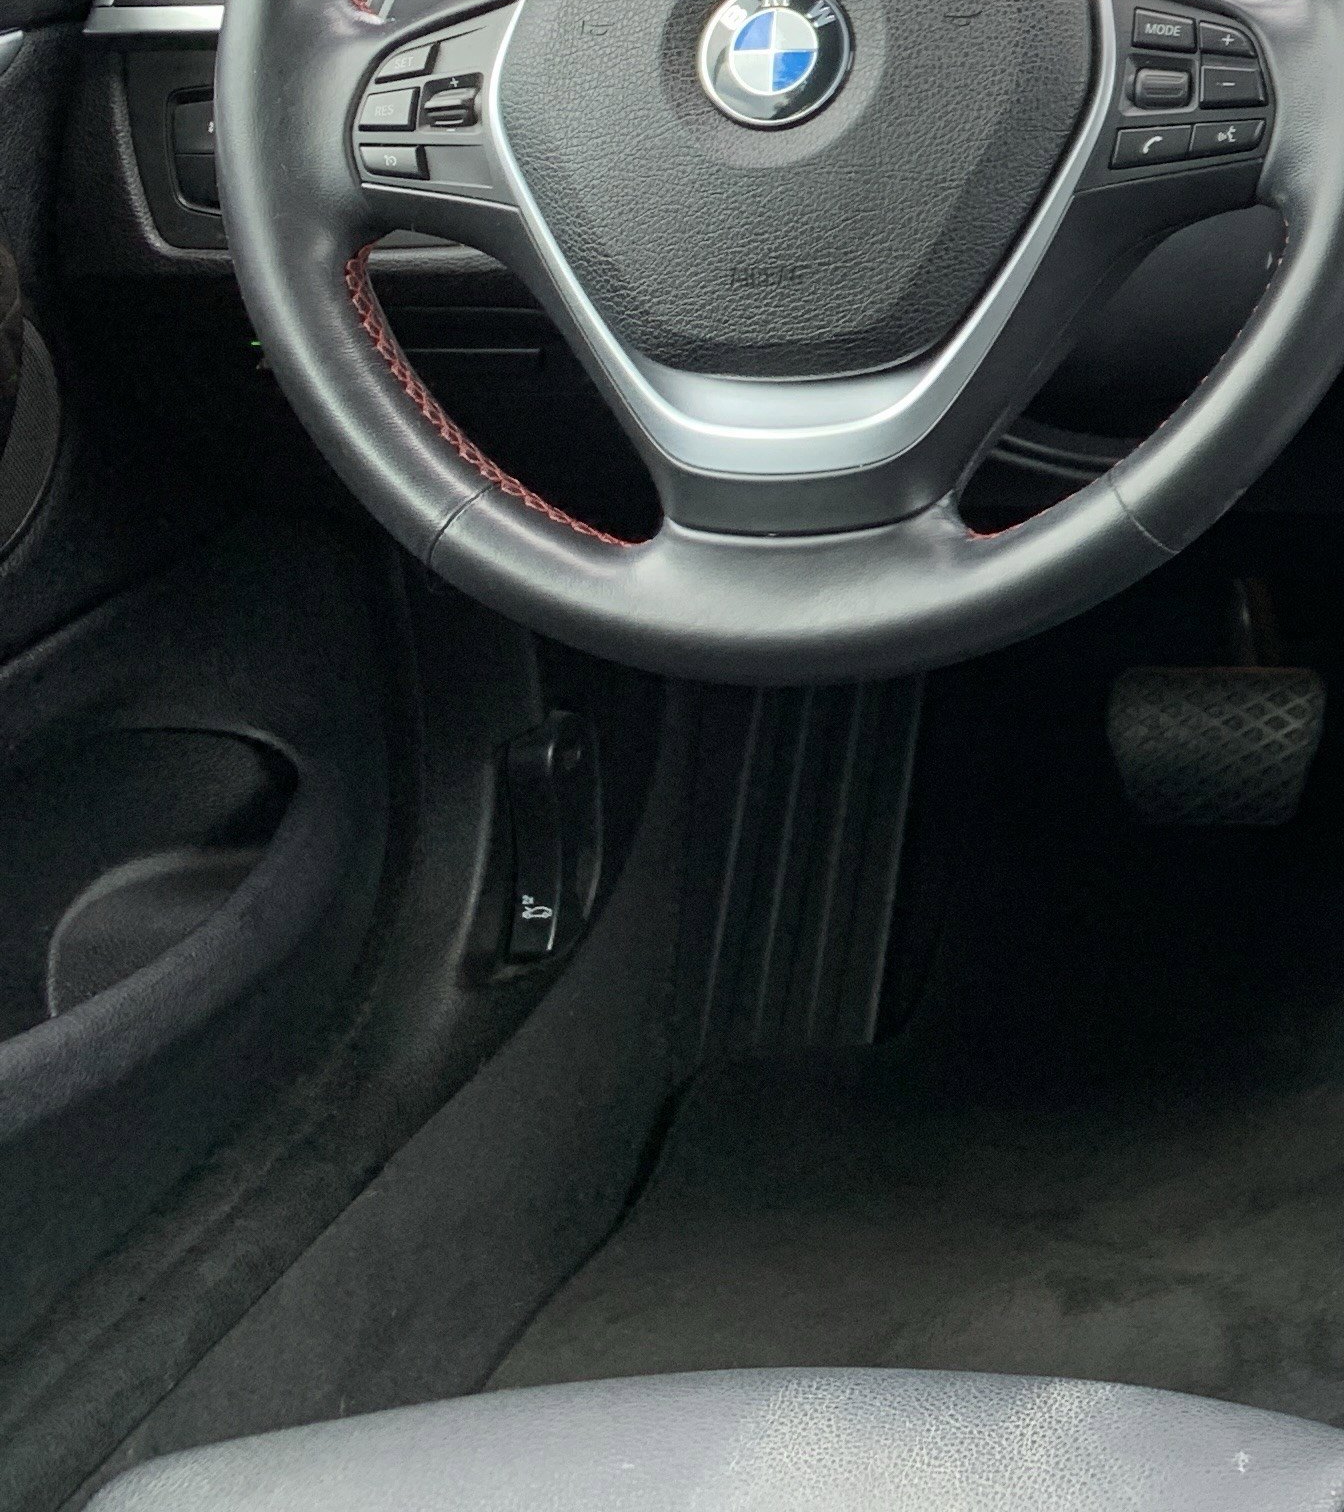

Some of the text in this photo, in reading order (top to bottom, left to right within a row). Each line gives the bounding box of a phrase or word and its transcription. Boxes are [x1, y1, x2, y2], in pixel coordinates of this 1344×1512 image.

[1145, 23, 1182, 37] MODE
[394, 57, 414, 69] SET
[374, 105, 394, 117] RES
